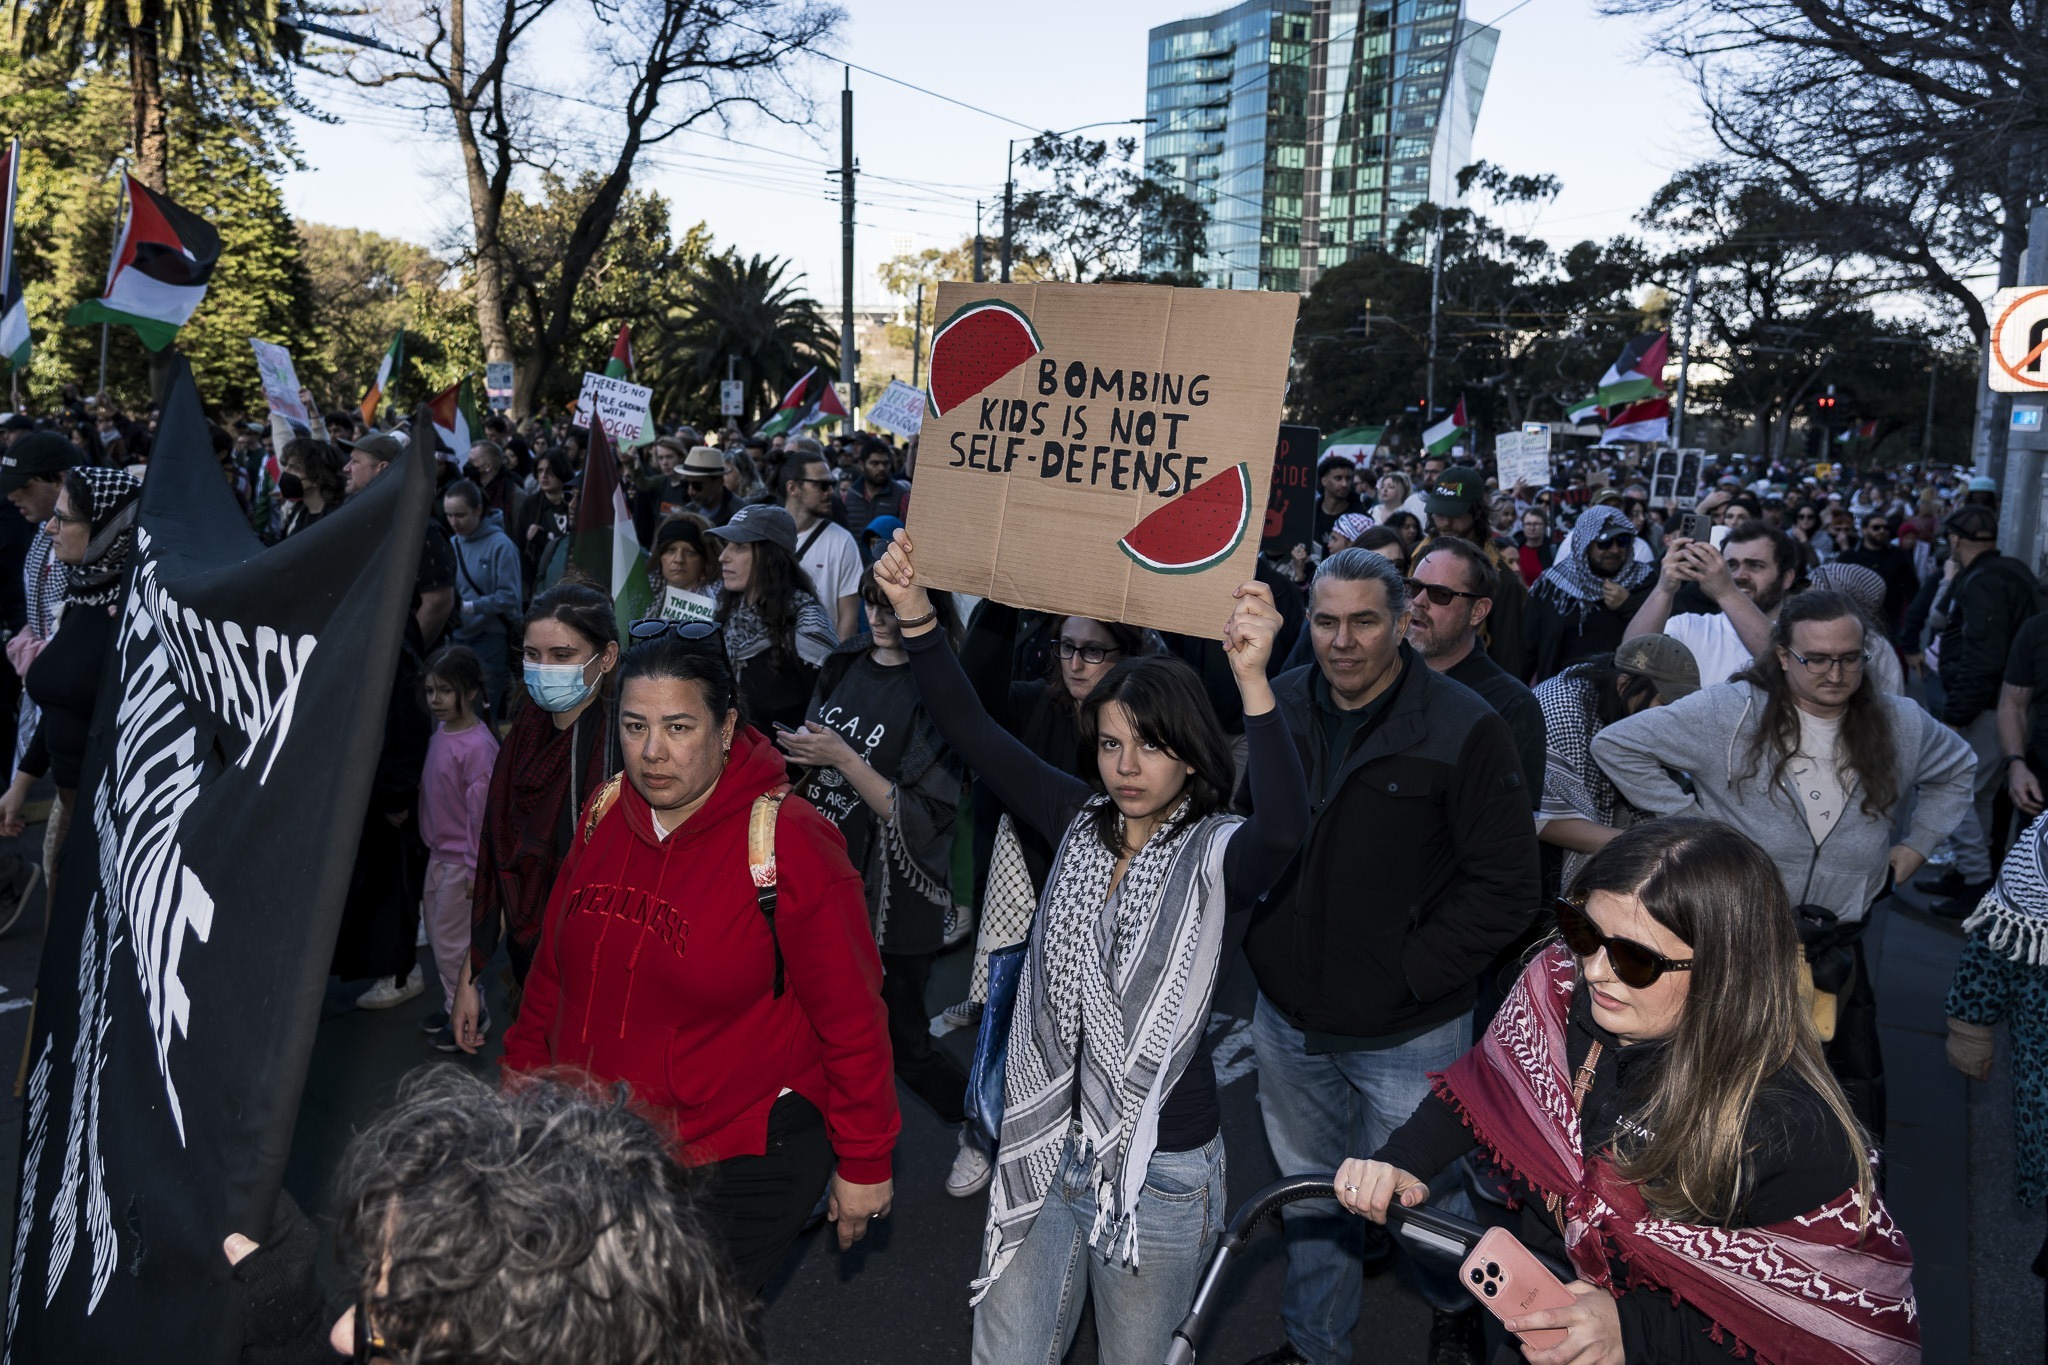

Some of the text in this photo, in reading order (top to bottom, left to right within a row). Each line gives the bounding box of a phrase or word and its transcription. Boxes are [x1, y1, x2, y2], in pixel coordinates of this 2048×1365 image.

[582, 374, 646, 398] THERE IS NO
[1038, 359, 1210, 406] BOMBING
[602, 406, 626, 418] WITH
[979, 397, 1189, 450] KIDS IS NOT
[949, 431, 1208, 497] SELF-DEFENSE
[663, 607, 680, 619] HAS
[671, 596, 714, 617] THE WORL
[825, 791, 848, 811] ARE
[566, 884, 690, 958] WELLNESS
